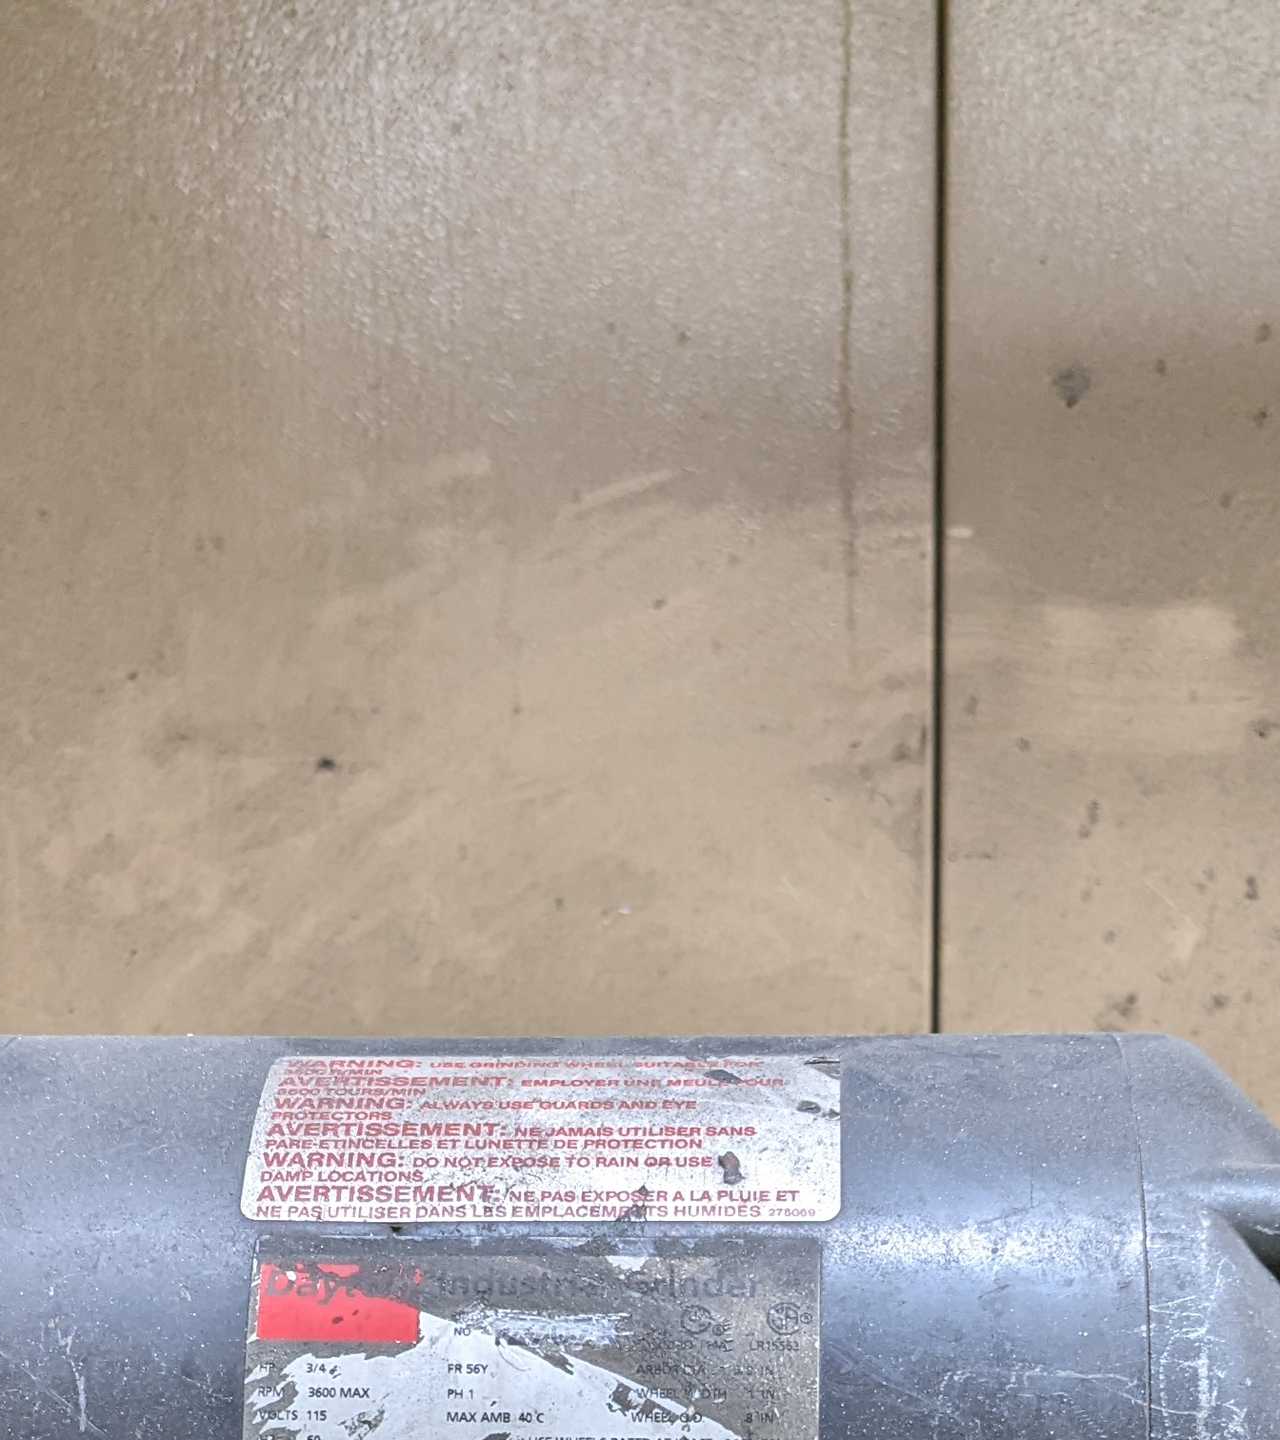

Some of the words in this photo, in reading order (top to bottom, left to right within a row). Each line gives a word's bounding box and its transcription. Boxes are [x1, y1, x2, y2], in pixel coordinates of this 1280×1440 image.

[287, 1060, 422, 1068] WARNING:
[278, 1077, 514, 1087] AVERTISSEMENT:
[521, 1079, 620, 1087] EMPLOYER
[274, 1098, 413, 1110] WARNING:
[420, 1101, 494, 1110] ALWAYS
[498, 1101, 533, 1110] USE
[539, 1101, 614, 1110] GUARDS
[619, 1101, 658, 1110] AND
[662, 1100, 698, 1110] EYE
[270, 1111, 393, 1121] PROTECTORS
[266, 1122, 508, 1137] AVERTISSEMENT:
[514, 1127, 541, 1137] NE
[544, 1127, 614, 1136] JAMAIS
[619, 1127, 702, 1136] UTILISER
[705, 1127, 757, 1136] SANS
[265, 1138, 432, 1150] PARE-ETINCELLES
[437, 1139, 459, 1150] ET
[464, 1139, 548, 1150] LUNETTE
[554, 1139, 578, 1150] DE
[583, 1139, 704, 1149] PROTECTION
[263, 1152, 405, 1168] WARNING:
[412, 1156, 439, 1168] DO
[444, 1156, 484, 1168] NOT
[490, 1156, 561, 1168] EXPOSE
[565, 1156, 591, 1168] TO
[596, 1156, 640, 1168] RAIN
[644, 1156, 671, 1168] OR
[675, 1156, 713, 1168] USE
[260, 1170, 314, 1182] DAMP
[318, 1170, 425, 1182] LOCATIONS
[256, 1185, 501, 1202] AVERTISSEMENT:
[509, 1190, 538, 1202] NE
[540, 1190, 576, 1202] PAS
[581, 1190, 665, 1202] EXPOSER
[672, 1190, 685, 1202] A
[690, 1190, 712, 1202] LA
[719, 1190, 770, 1202] PLUIE
[775, 1190, 801, 1202] ET
[256, 1206, 281, 1218] NE
[287, 1206, 322, 1218] PAS
[328, 1206, 410, 1219] UTILISER
[416, 1206, 467, 1219] DANS
[472, 1206, 507, 1219] LES
[673, 1206, 761, 1218] HUMIDES
[306, 1362, 326, 1374] 3/4
[447, 1364, 463, 1374] FR
[466, 1364, 489, 1374] 56Y
[257, 1387, 285, 1398] RPM
[308, 1388, 337, 1399] 3600
[340, 1388, 370, 1399] MAX
[447, 1389, 464, 1399] PH
[306, 1410, 328, 1421] 115
[446, 1412, 477, 1422] MAX
[480, 1412, 511, 1423] AMB
